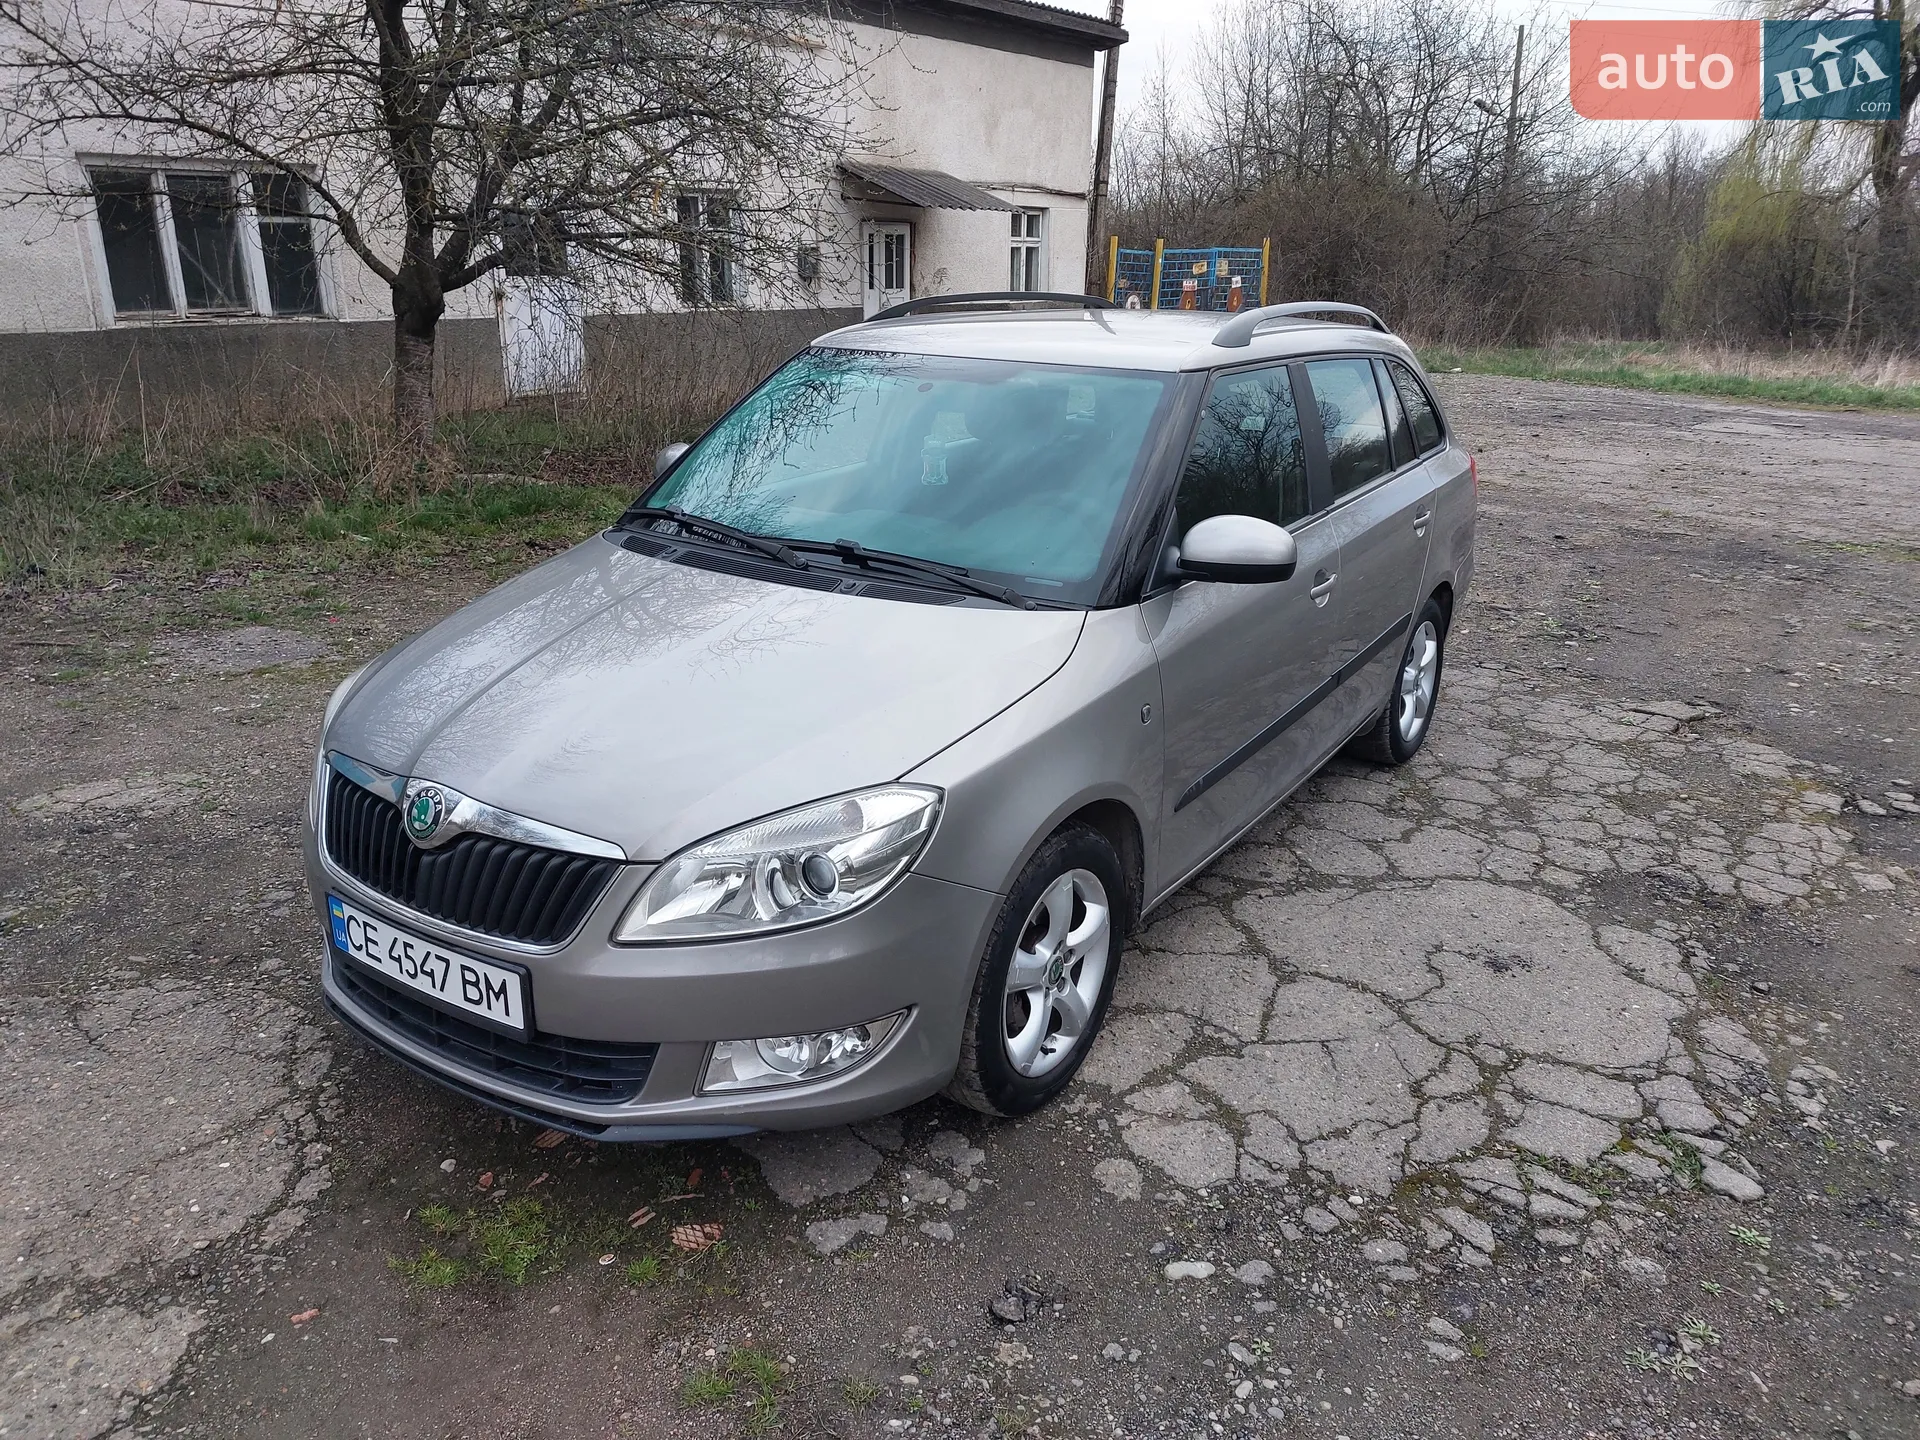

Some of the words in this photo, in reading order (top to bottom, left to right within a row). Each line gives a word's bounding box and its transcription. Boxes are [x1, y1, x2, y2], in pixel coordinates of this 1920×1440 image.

[335, 928, 347, 943] UA
[346, 914, 382, 964] CE
[388, 936, 451, 993] 4547
[459, 963, 511, 1017] BM
